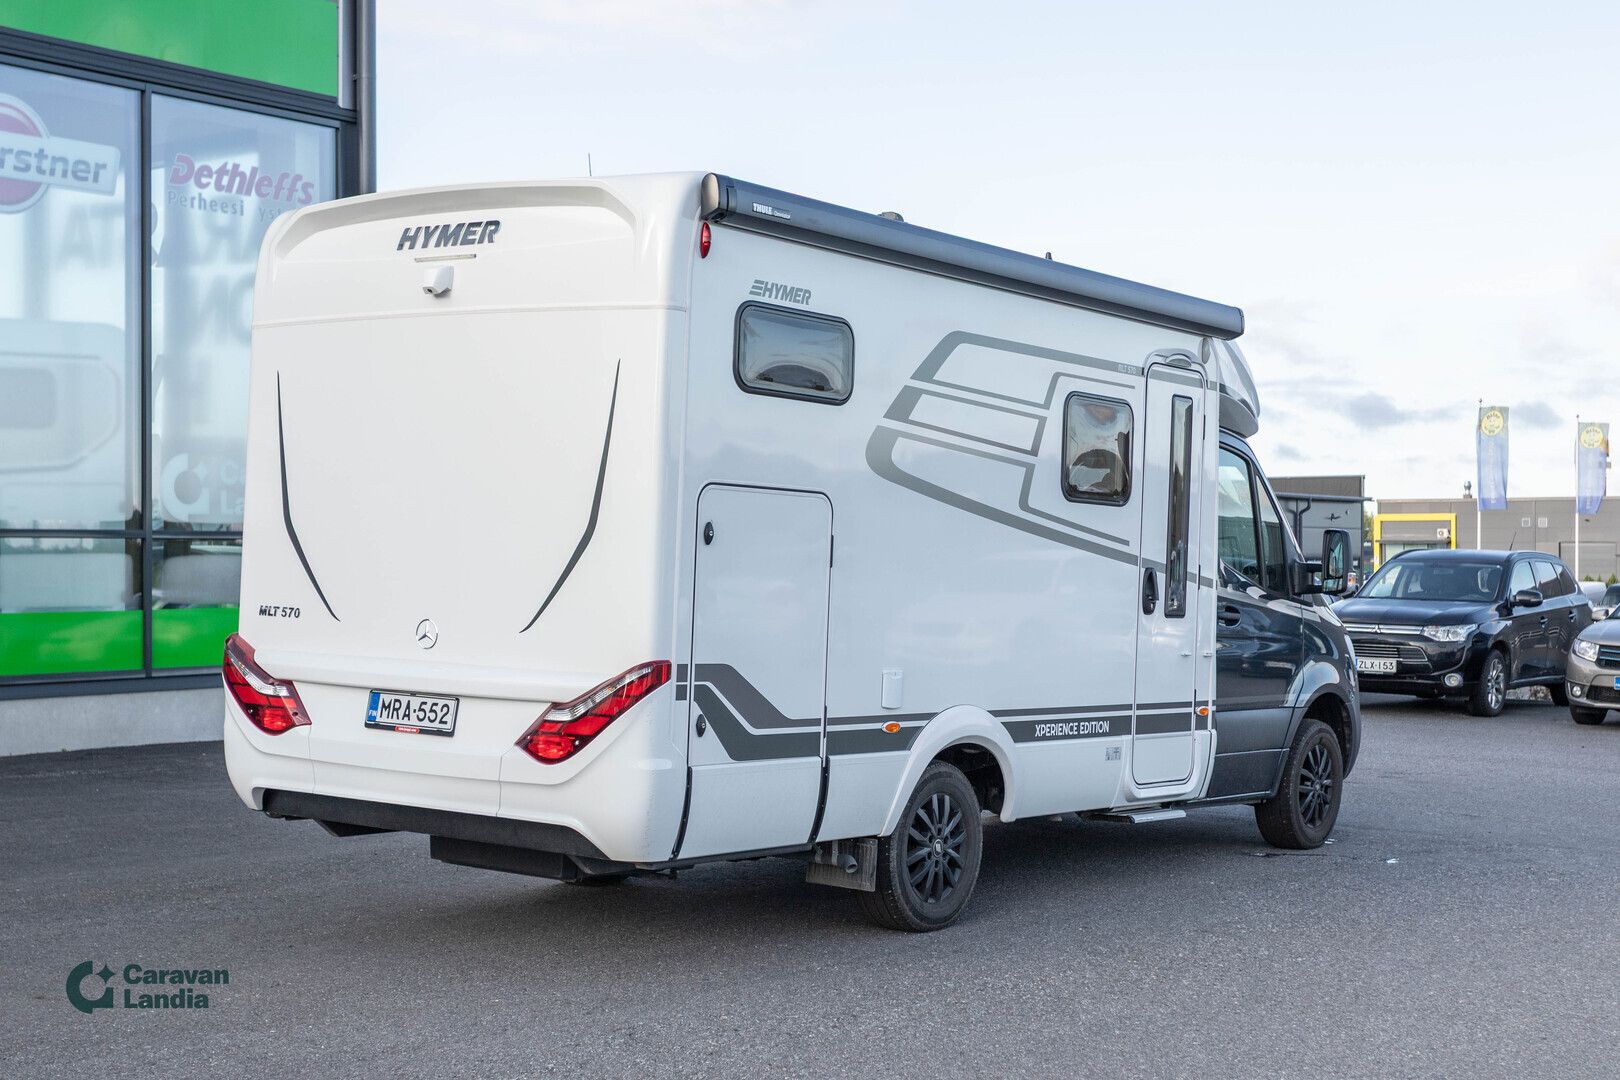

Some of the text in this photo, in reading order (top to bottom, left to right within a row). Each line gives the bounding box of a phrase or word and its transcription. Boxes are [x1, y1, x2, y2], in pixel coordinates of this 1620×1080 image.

[169, 153, 315, 205] Dethleffs
[168, 191, 245, 216] Perheesi
[753, 203, 773, 215] THULE
[396, 219, 501, 251] HYMER
[760, 280, 812, 305] HYMER
[258, 605, 301, 619] MLT 570
[1358, 659, 1394, 671] ZLX-153
[380, 698, 450, 725] MRA-552
[1034, 720, 1110, 738] XPERIENCE EDITION
